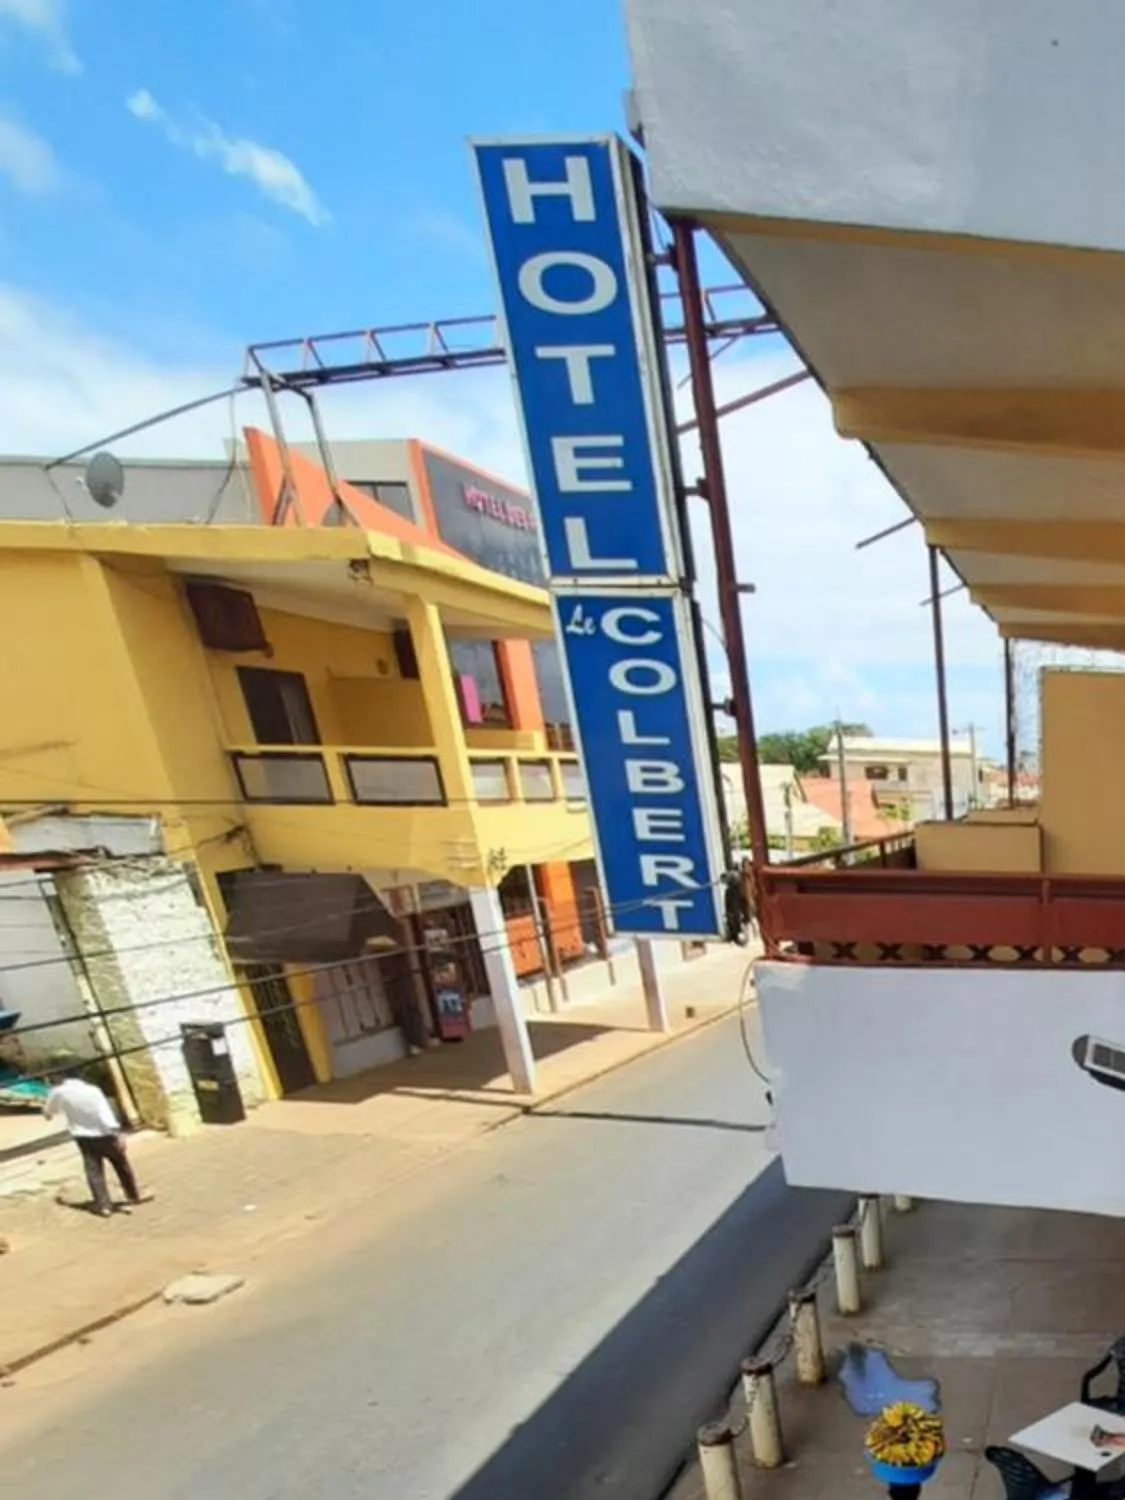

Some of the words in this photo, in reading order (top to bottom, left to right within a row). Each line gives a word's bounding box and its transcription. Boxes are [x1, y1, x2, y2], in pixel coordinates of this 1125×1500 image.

[502, 156, 638, 571] HOTEL
[565, 604, 597, 635] Le
[601, 606, 702, 930] COLBERT
